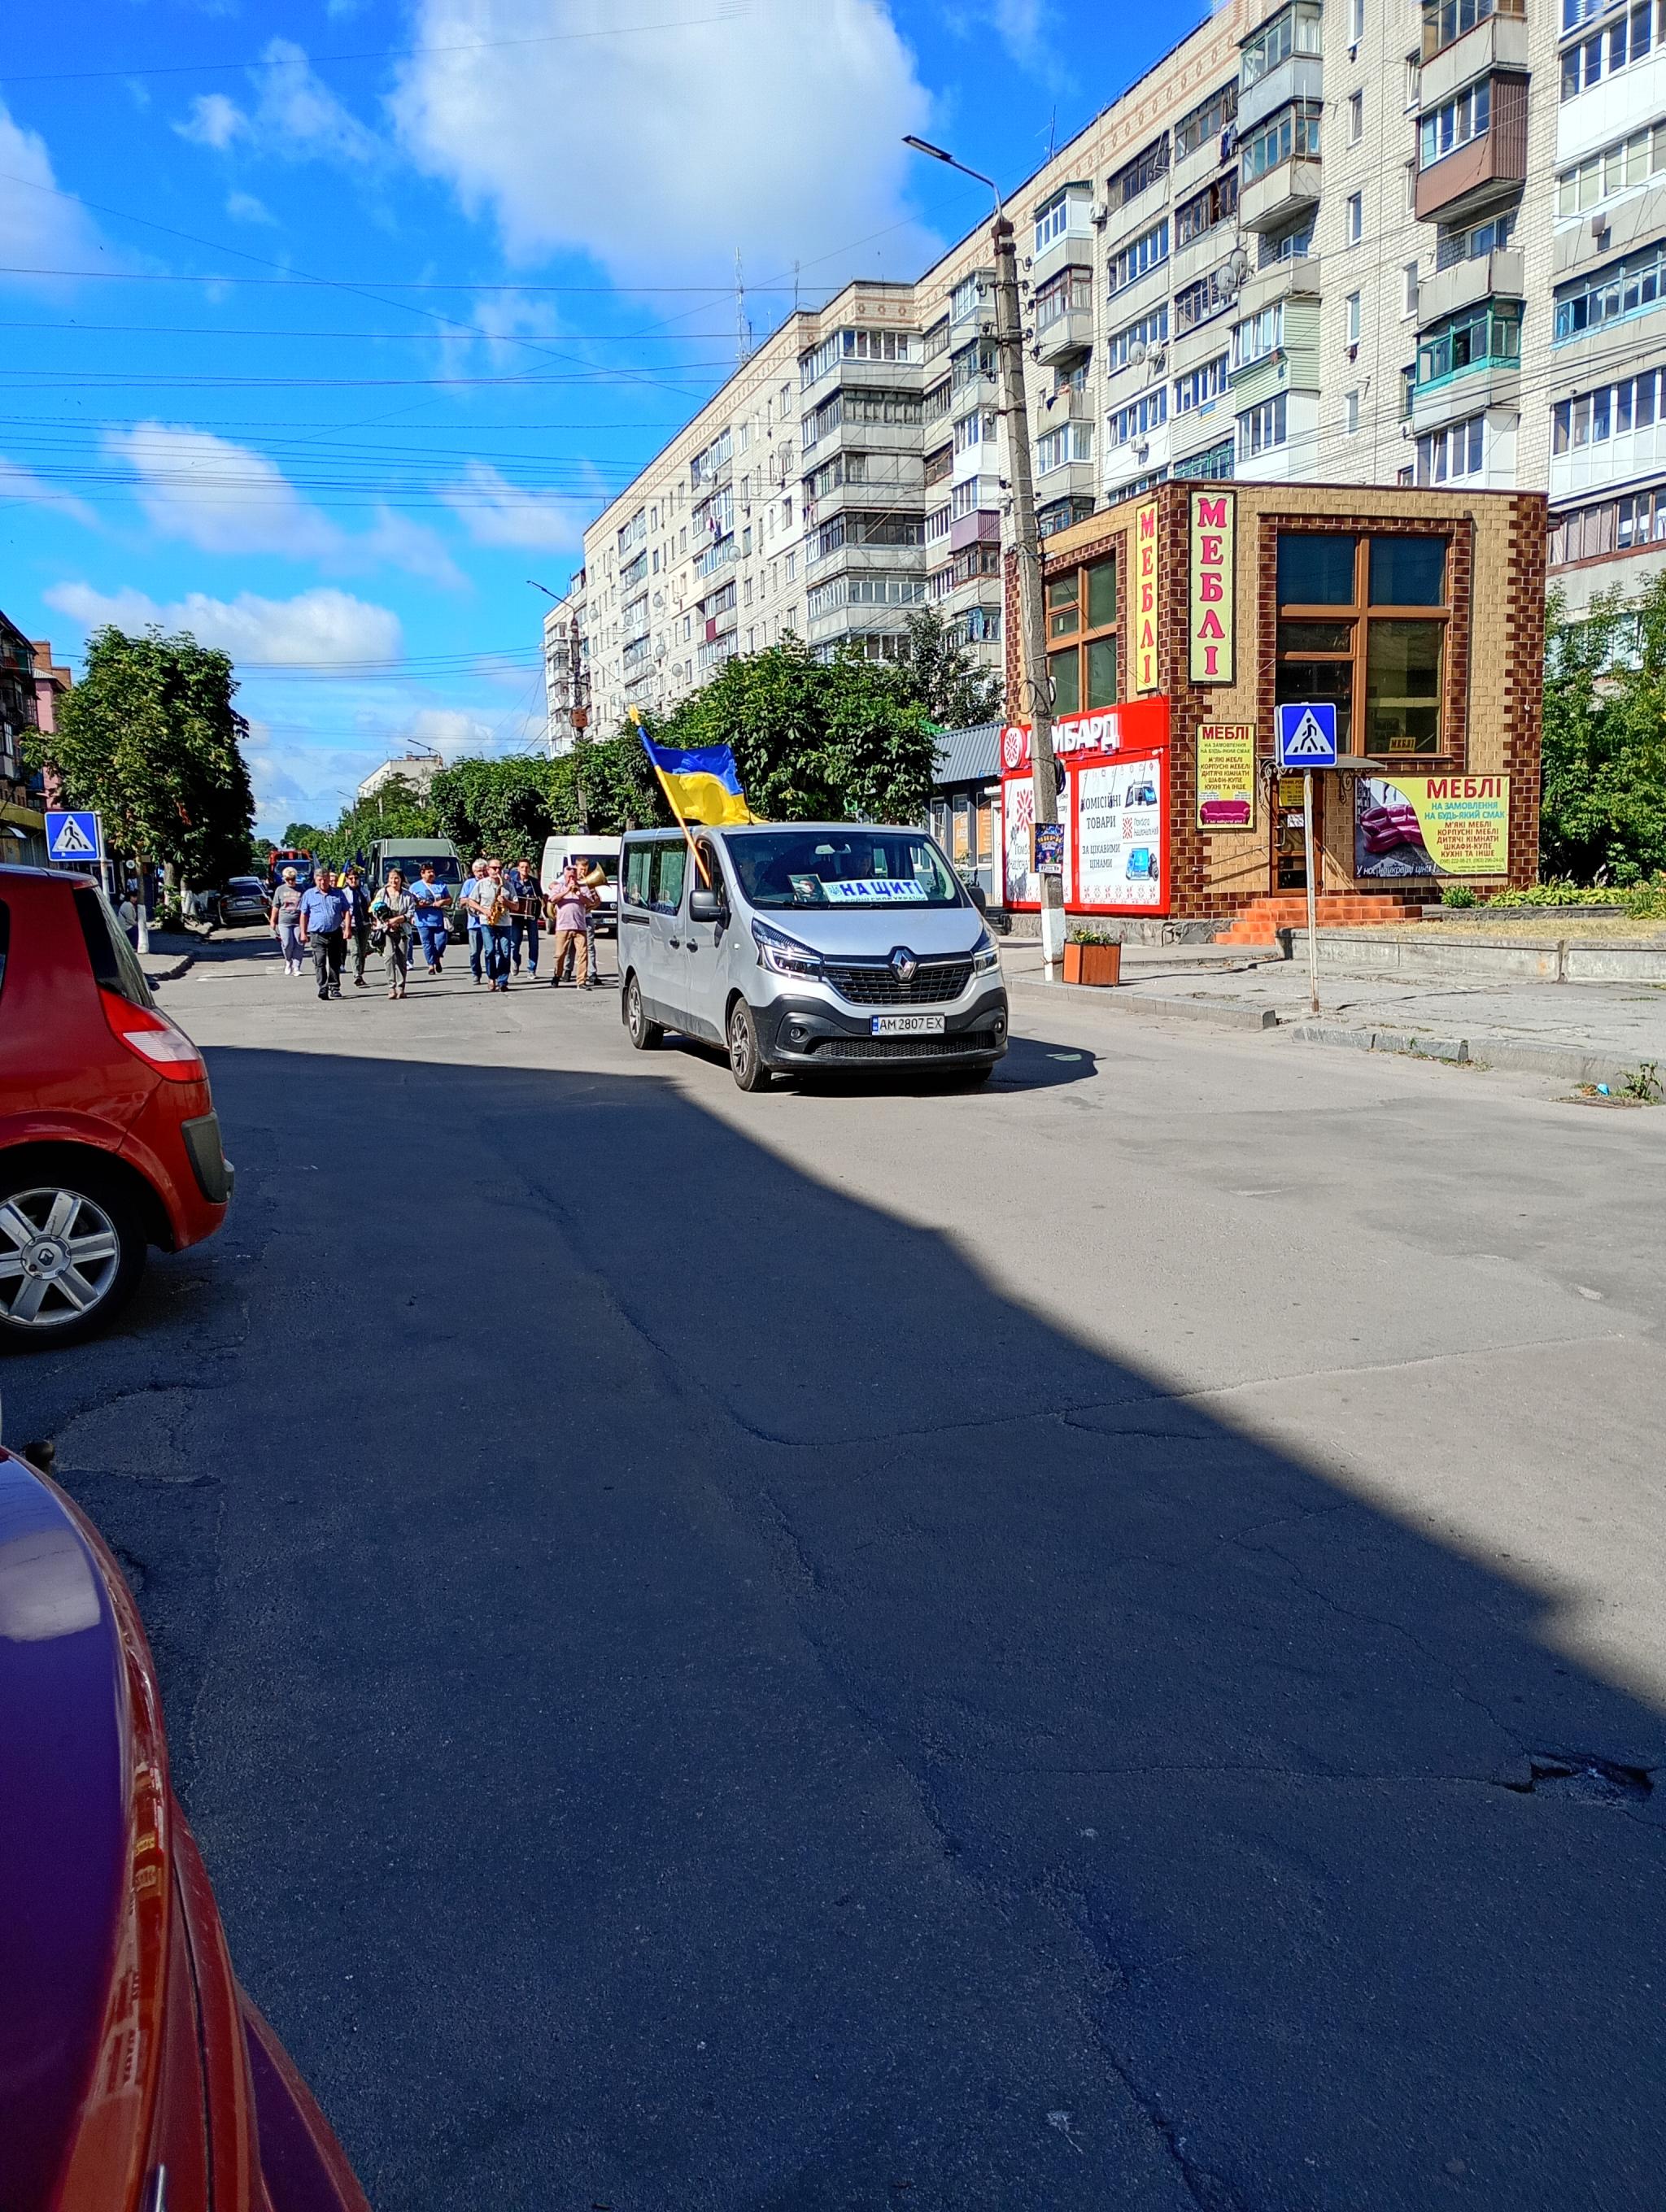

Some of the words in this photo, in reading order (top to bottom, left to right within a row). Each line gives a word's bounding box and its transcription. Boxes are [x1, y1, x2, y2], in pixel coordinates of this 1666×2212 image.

[1197, 497, 1228, 676] МЕБЛІ
[1140, 507, 1155, 684] МЕБЛІ
[1202, 726, 1249, 740] МЕБЛІ
[1427, 778, 1502, 799] МЕБЛІ
[1432, 802, 1442, 810] НА
[1445, 801, 1498, 810] ЗАМОВЛЕННЯ
[1437, 810, 1480, 821] БУДЬ-ЯКИЙ
[1087, 816, 1116, 830] ТОВАРИ
[1437, 836, 1464, 844] ДИТЯЧІ
[1466, 835, 1499, 843] КІМНАТИ
[1082, 846, 1089, 855] ЗА
[1090, 844, 1120, 856] ЦІКАВИМИ
[1476, 849, 1495, 857] ІНШЕ
[1089, 859, 1112, 870] ЦІНАМИ
[839, 882, 870, 896] НА
[871, 881, 923, 897] ЩИТІ
[880, 1019, 895, 1030] AM
[898, 1018, 924, 1030] 2807
[927, 1017, 942, 1029] EX
